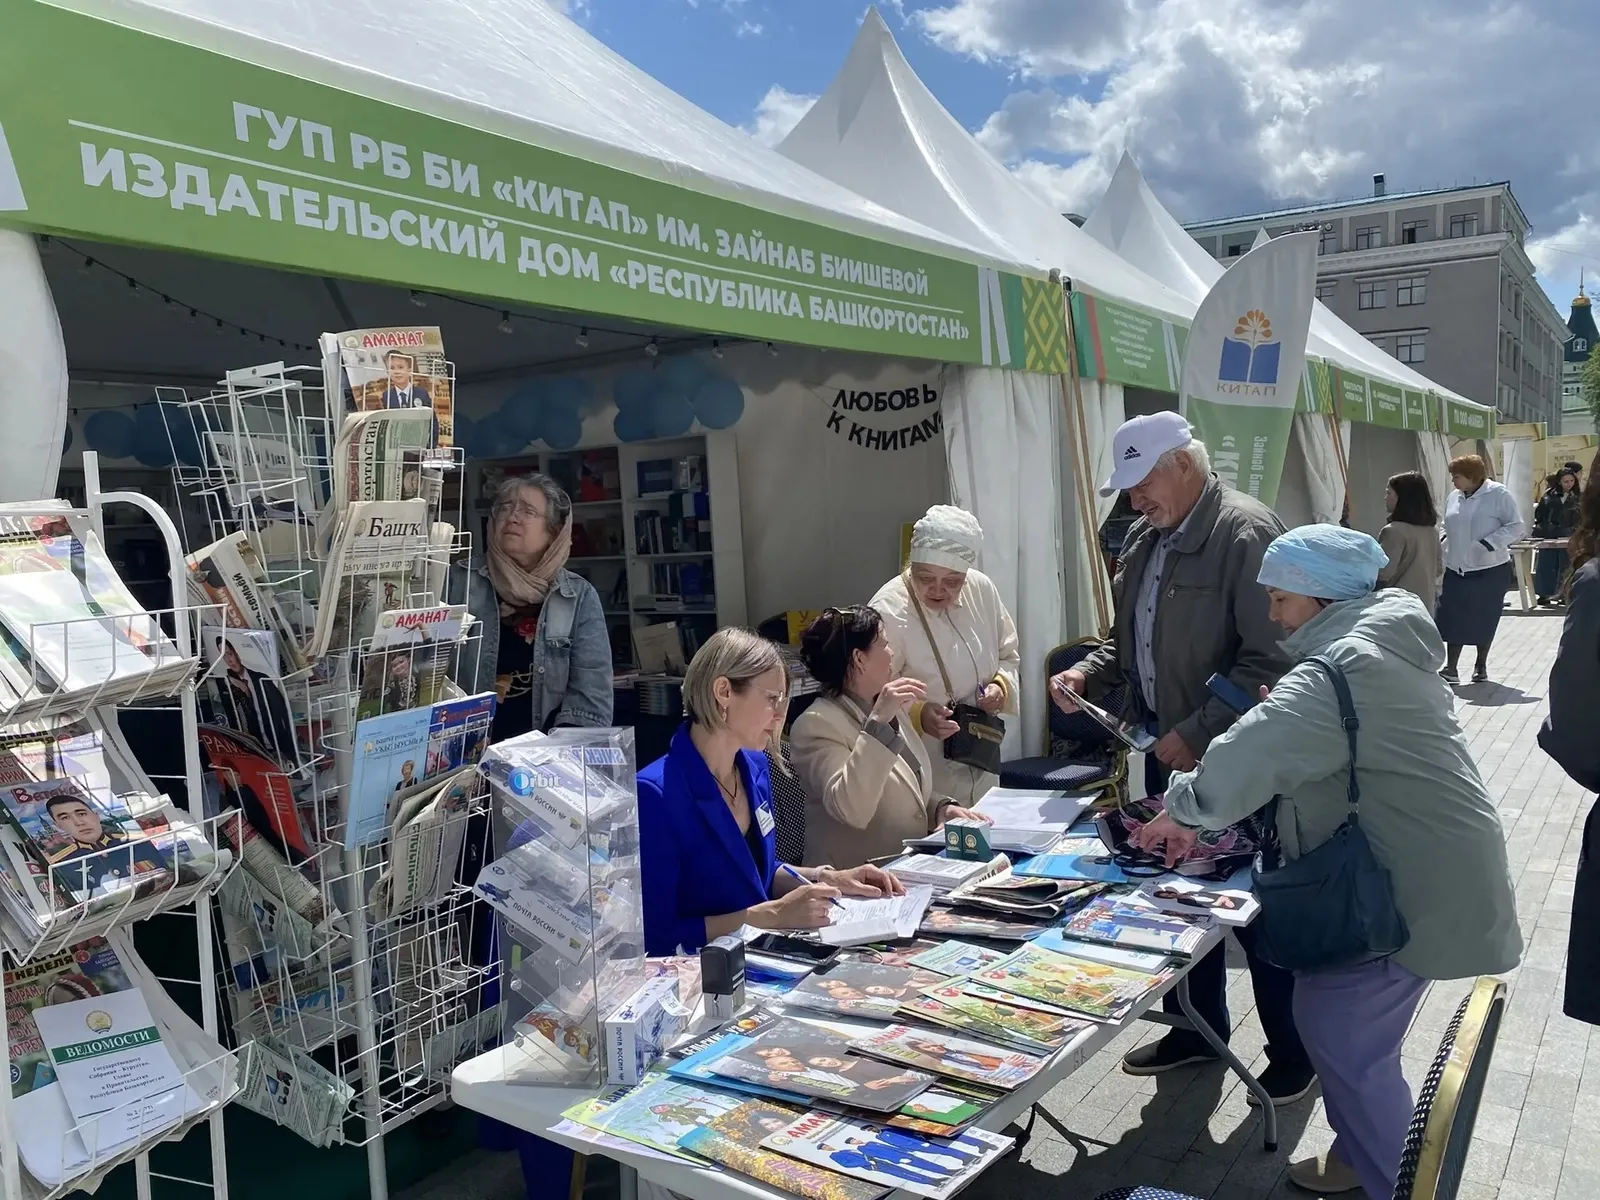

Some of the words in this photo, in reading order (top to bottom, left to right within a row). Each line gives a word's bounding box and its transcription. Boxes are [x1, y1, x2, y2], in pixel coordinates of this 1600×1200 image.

[232, 101, 335, 163] ГУП
[350, 132, 411, 180] РБ
[422, 151, 481, 198] БИ
[492, 176, 649, 235] «КИТАП»
[656, 213, 709, 253] ИМ.
[715, 229, 816, 274] ЗАЙНАБ
[820, 253, 929, 296] БИИШЕВОЙ
[80, 142, 506, 263] ИЗДАТЕЛЬСКИЙ
[517, 236, 600, 282] ДОМ
[609, 260, 804, 318] «РЕСПУБЛИКА
[808, 295, 969, 340] БАШКОРТОСТАН»
[362, 330, 424, 348] АМАНАТ
[832, 384, 937, 412] ЛЮБОВЬ
[1216, 383, 1276, 396] КИТАП
[826, 410, 845, 434] К
[1123, 452, 1141, 461] adidas
[395, 609, 450, 628] АМАНАТ
[510, 769, 562, 792] Orbit
[533, 795, 558, 815] РОССИИ
[512, 901, 533, 919] ПОЧТА
[532, 914, 557, 935] РОССИИ
[15, 955, 74, 981] НЕДЕЛЯ
[65, 1030, 151, 1058] ВЕДОМОСТИ
[615, 1027, 623, 1045] ПОЧТА
